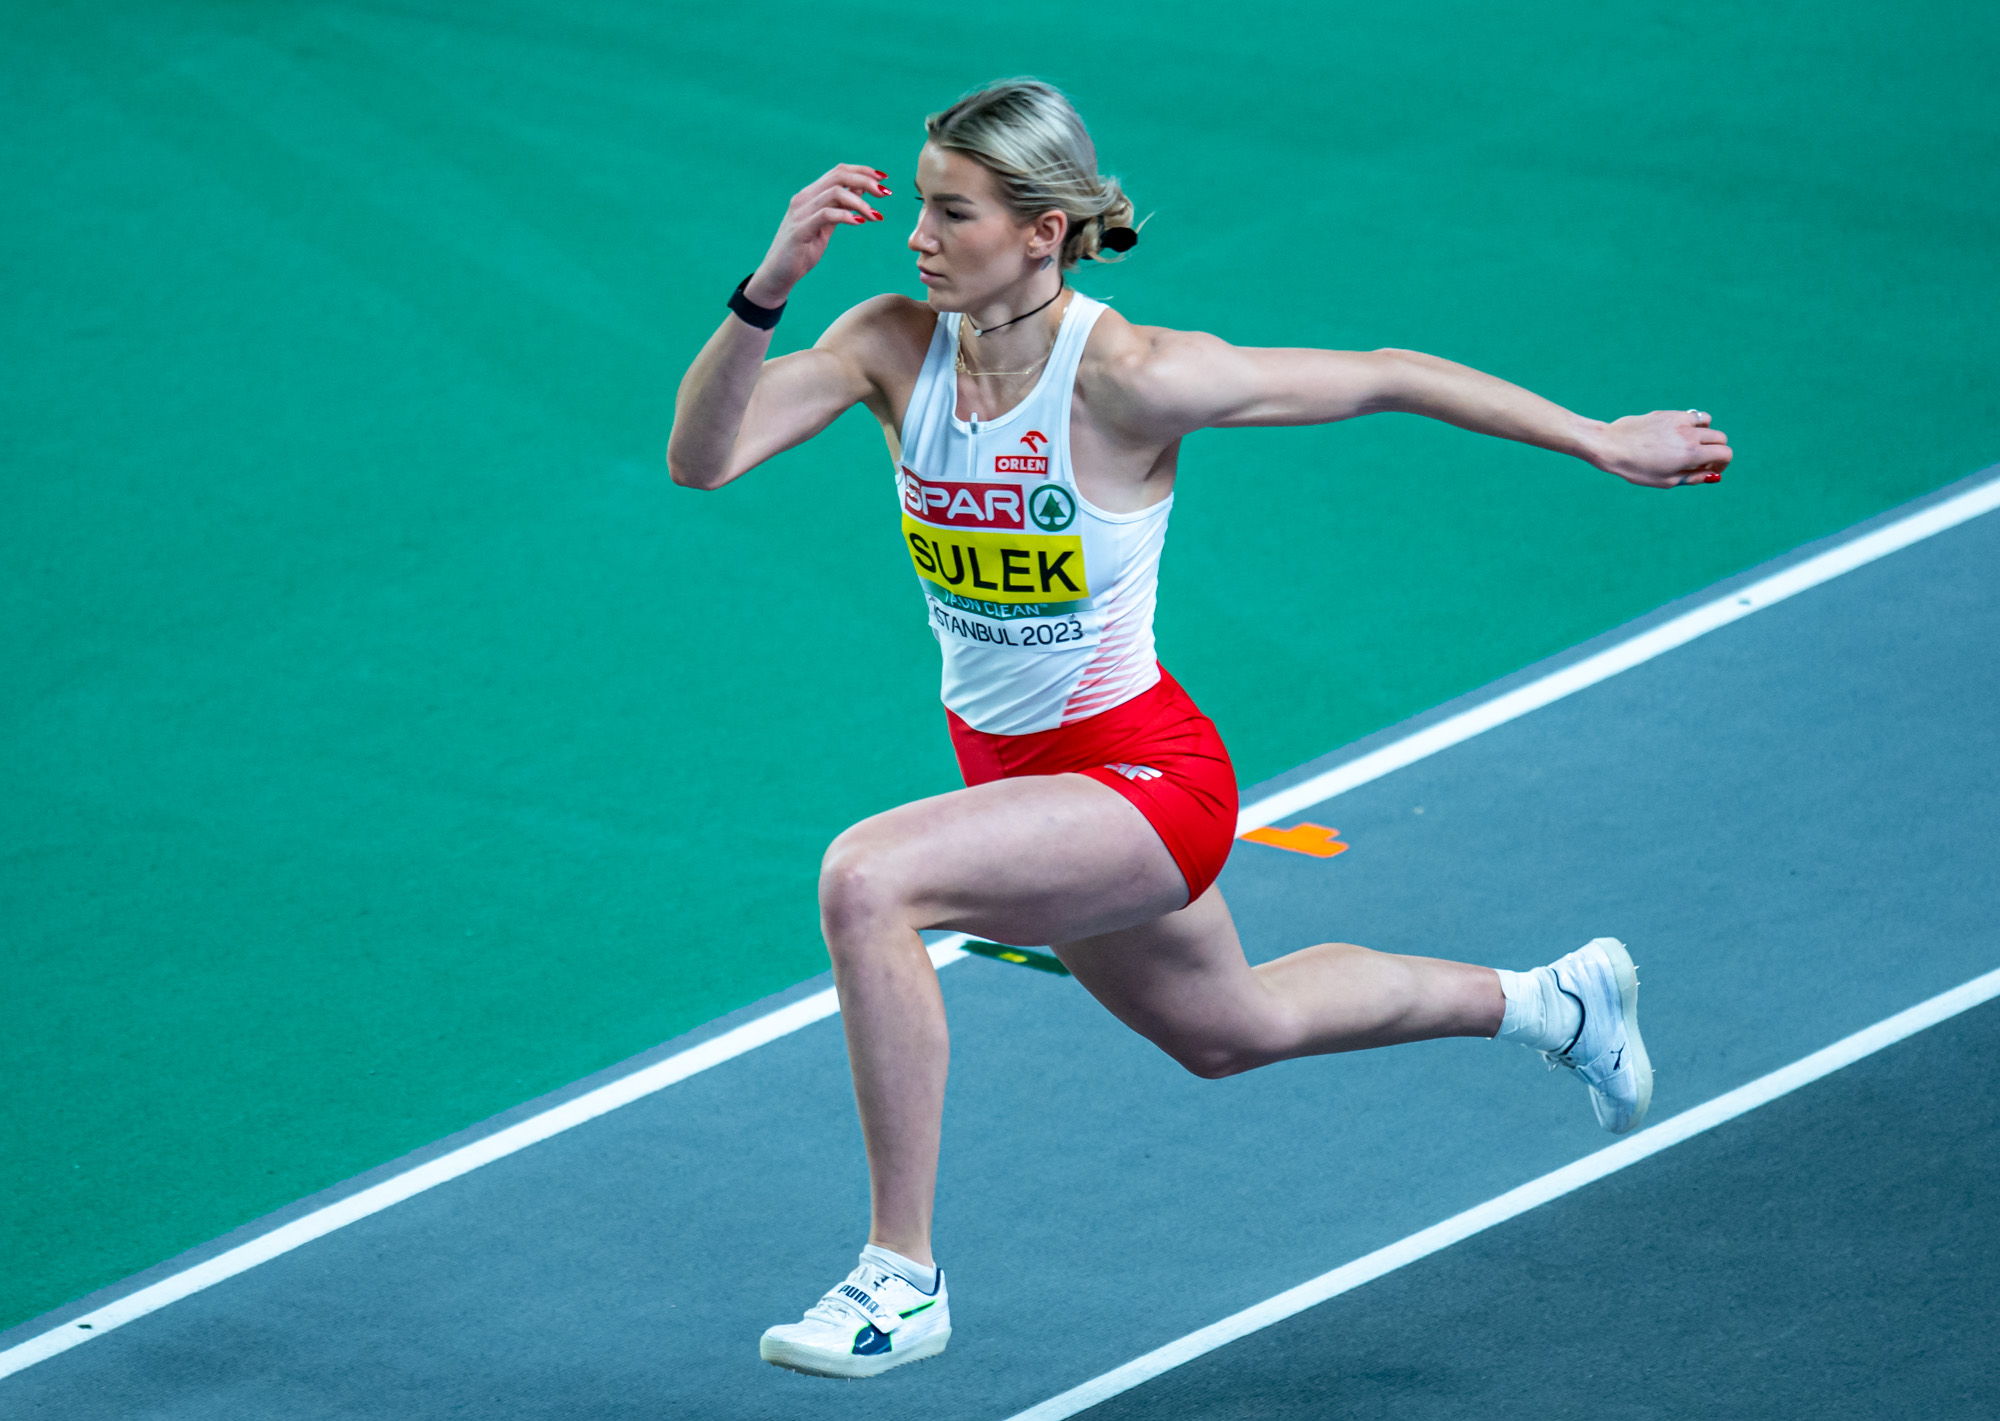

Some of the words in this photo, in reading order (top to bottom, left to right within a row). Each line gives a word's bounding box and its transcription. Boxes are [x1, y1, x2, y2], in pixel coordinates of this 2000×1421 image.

[997, 457, 1046, 472] ORLEN
[905, 474, 1022, 523] SPAR
[909, 532, 1081, 594] SULEK
[1021, 620, 1084, 646] 2023
[837, 1284, 880, 1314] PUMA
